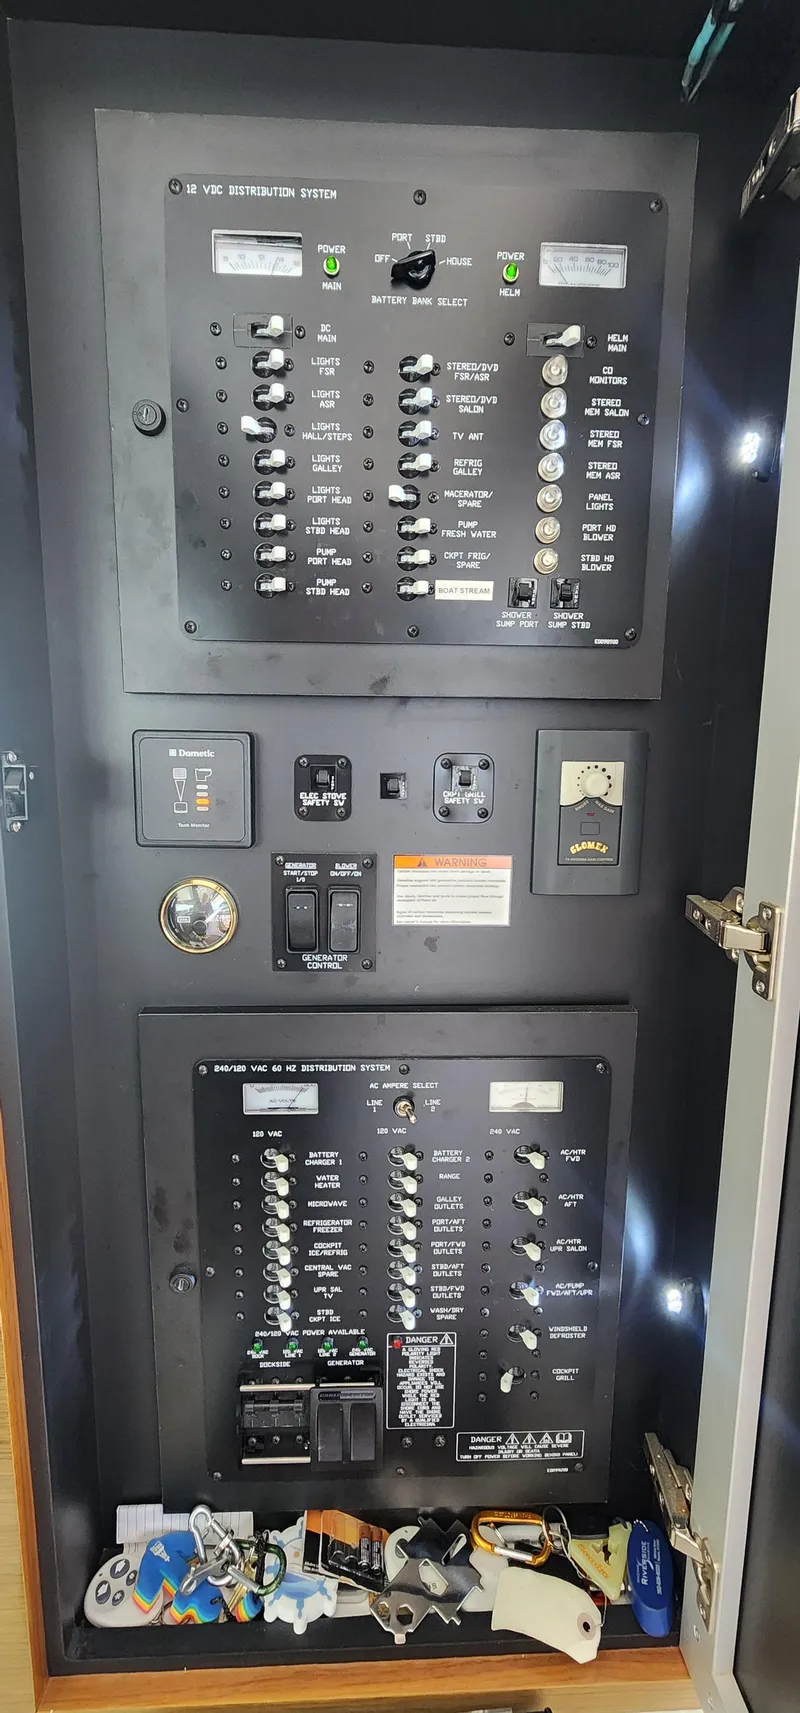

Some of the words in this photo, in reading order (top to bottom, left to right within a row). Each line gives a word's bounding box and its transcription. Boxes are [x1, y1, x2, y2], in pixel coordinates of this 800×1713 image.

[186, 186, 197, 194] 12
[203, 186, 223, 195] VDC
[229, 186, 295, 197] DISTRIBUTION
[300, 188, 337, 199] SYSTEM
[392, 233, 413, 241] PORT
[425, 234, 446, 243] STBD
[318, 245, 346, 254] POWER
[375, 254, 391, 263] OFF
[497, 252, 524, 261] POWER
[446, 257, 472, 266] HOUSE
[322, 282, 341, 290] MAIN
[500, 288, 520, 297] HELM
[372, 295, 407, 305] BATTERY
[412, 297, 432, 306] BANK
[438, 298, 468, 306] SELECT
[321, 324, 331, 332] DC
[608, 334, 628, 342] HELM
[608, 344, 627, 352] MAIN
[311, 357, 340, 366] LIGHTS
[447, 362, 498, 372] STEREO/DVD
[603, 366, 613, 374] CO
[319, 368, 335, 376] FSR
[454, 373, 489, 381] FSR/ASR
[589, 376, 628, 385] MONITORS
[311, 390, 340, 398] LIGHTS
[446, 395, 497, 404] STEREO/DVD
[592, 398, 621, 407] STEREO
[319, 400, 335, 408] ASR
[459, 405, 484, 413] SALON
[585, 408, 600, 416] MEM
[604, 408, 629, 417] SALON
[312, 423, 340, 431] LIGHTS
[302, 432, 352, 441] HALL/STEPS
[452, 432, 464, 440] TV
[468, 432, 484, 440] ANT
[590, 430, 619, 439] STEREO
[607, 440, 622, 448] FSR
[312, 455, 340, 463] LIGHTS
[454, 459, 482, 467] REFRIG
[312, 464, 342, 473] GALLEY
[588, 462, 617, 470] STEREO
[453, 468, 482, 476] GALLEY
[605, 472, 620, 480] ASR
[312, 486, 340, 494] LIGHTS
[444, 490, 493, 499] MACERATOR/
[589, 493, 613, 501] PANEL
[307, 496, 327, 504] PORT
[332, 496, 352, 504] HEAD
[458, 500, 482, 508] SPARE
[586, 503, 613, 511] LIGHTS
[312, 517, 340, 525] LIGHTS
[306, 527, 325, 535] STBD
[330, 527, 350, 535] HEAD
[582, 524, 601, 532] PORT
[606, 524, 616, 532] HD
[441, 530, 466, 538] FRESH
[316, 548, 337, 556] PUMP
[444, 552, 463, 560] CKPT
[468, 552, 491, 560] FRIG/
[332, 558, 352, 566] HEAD
[330, 588, 350, 596] HEAD
[502, 611, 532, 619] SHOWER
[548, 621, 567, 629] SUMP
[179, 749, 215, 758] Dometic
[300, 792, 319, 800] ELEC
[322, 792, 347, 800] STOVE
[302, 799, 330, 807] SAFETY
[334, 799, 345, 807] SW
[569, 841, 609, 854] GLOMEX
[434, 858, 487, 867] WARNING
[302, 954, 348, 962] GENERATOR
[307, 962, 342, 970] CONTROL
[301, 1064, 356, 1072] DISTRIBUTION
[406, 1336, 438, 1344] DANGER
